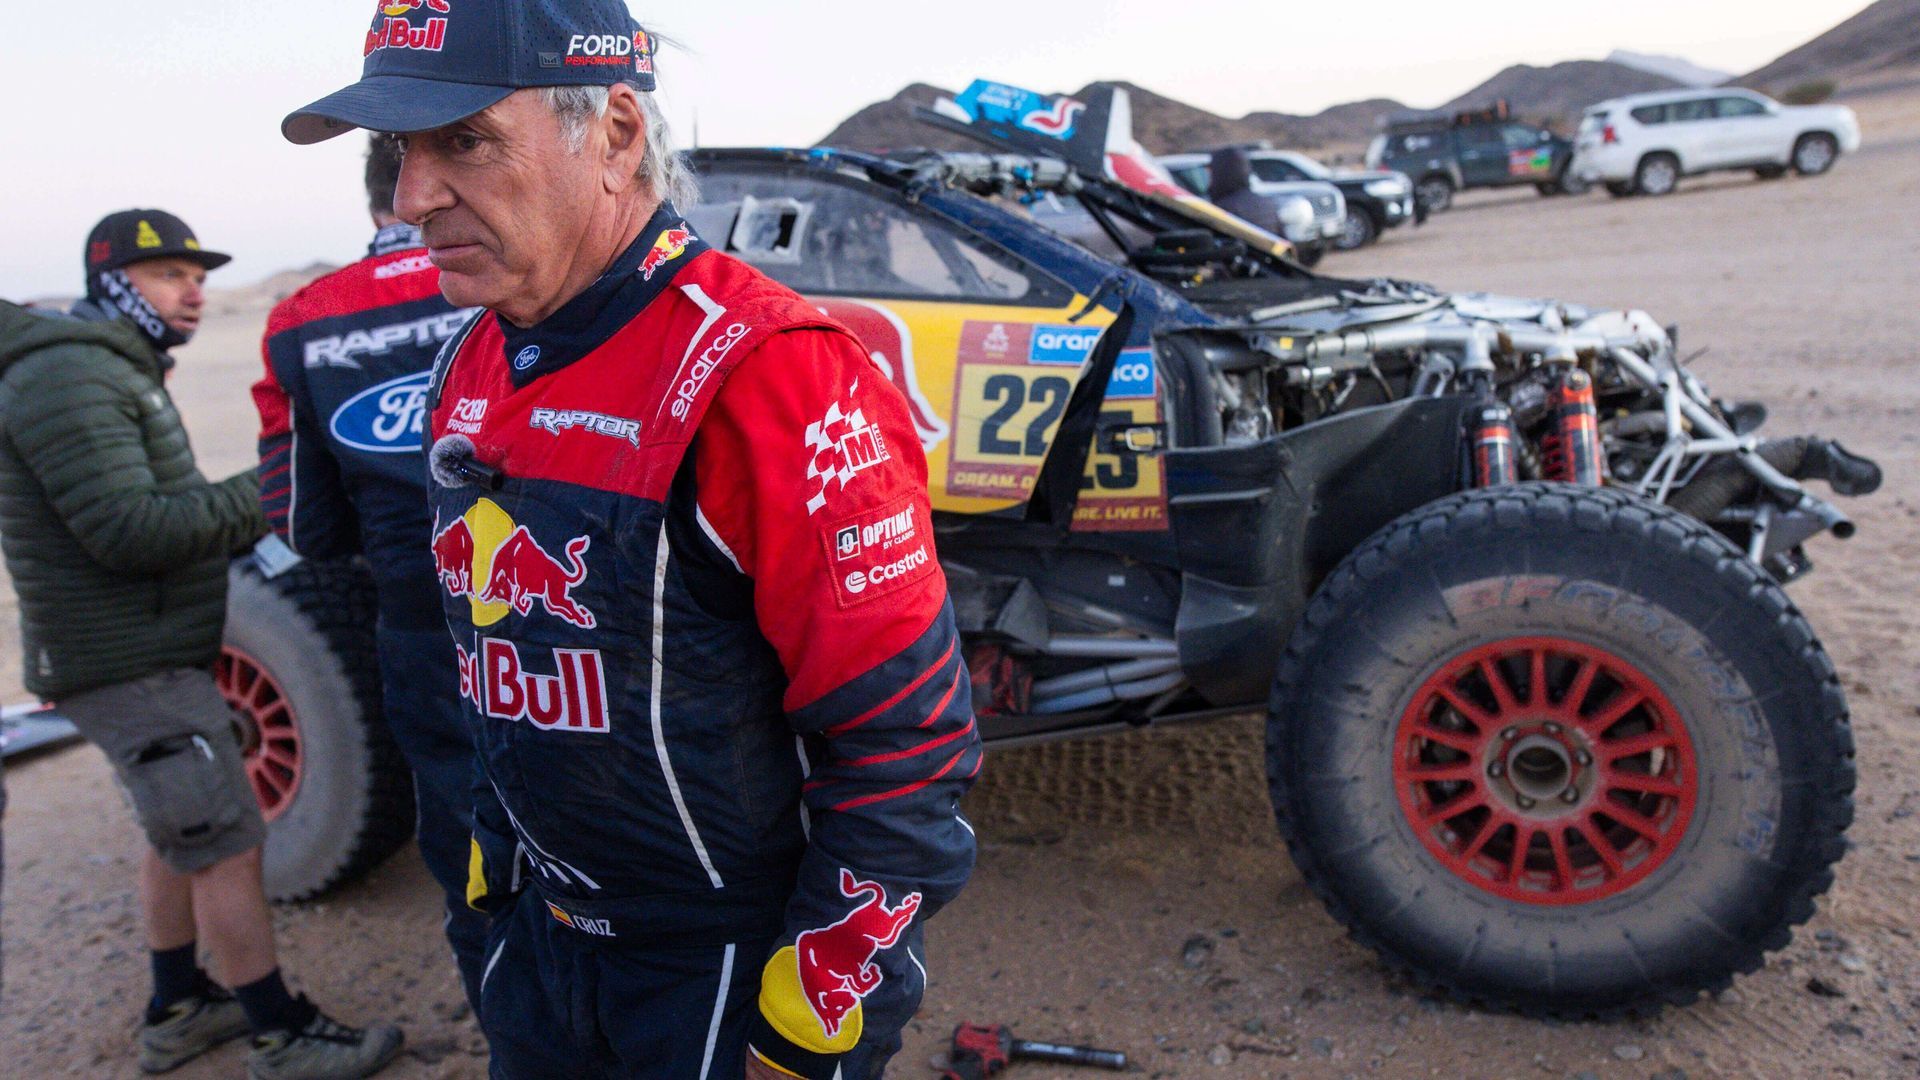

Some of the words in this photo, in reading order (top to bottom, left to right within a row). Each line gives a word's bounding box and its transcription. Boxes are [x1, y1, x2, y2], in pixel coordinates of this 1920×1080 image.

[389, 17, 448, 51] Bull
[567, 35, 631, 56] FORD
[564, 56, 631, 66] PERFORMANCE
[671, 322, 751, 422] sparco
[450, 397, 488, 421] FORD
[979, 374, 1071, 457] 22
[529, 406, 642, 450] RAPTOR
[873, 424, 890, 460] SPORT
[883, 541, 893, 550] BY
[868, 544, 929, 585] Castrol
[483, 637, 610, 733] Bull
[573, 914, 616, 937] CRUZ
